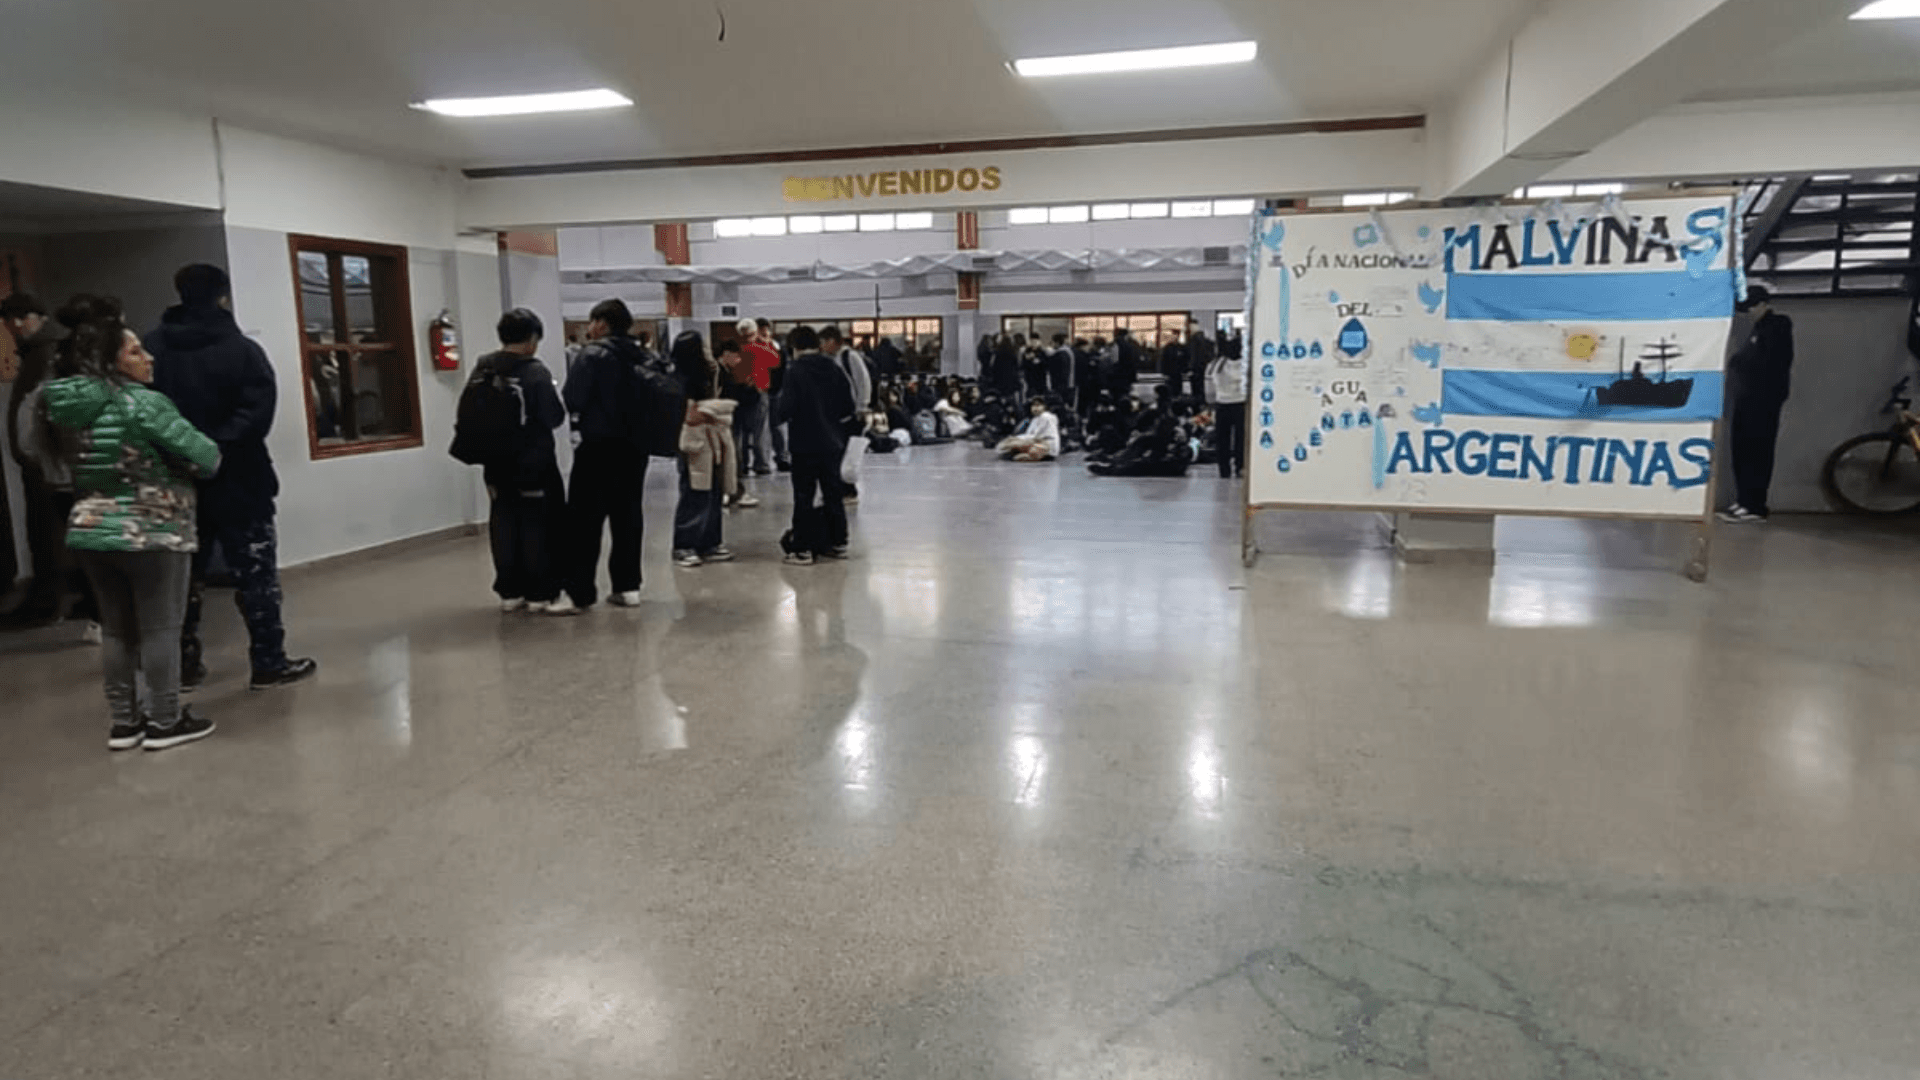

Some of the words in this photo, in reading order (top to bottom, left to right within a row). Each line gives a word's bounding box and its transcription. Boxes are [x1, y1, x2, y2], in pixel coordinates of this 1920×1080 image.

[782, 166, 1001, 202] NVENIDOS
[1442, 206, 1726, 274] MALVINAS
[1337, 303, 1373, 318] DEL
[1261, 341, 1323, 360] CADA
[1260, 364, 1276, 449] GOTA
[1321, 381, 1368, 407] AGUA
[1385, 429, 1716, 489] ARGENTINAS
